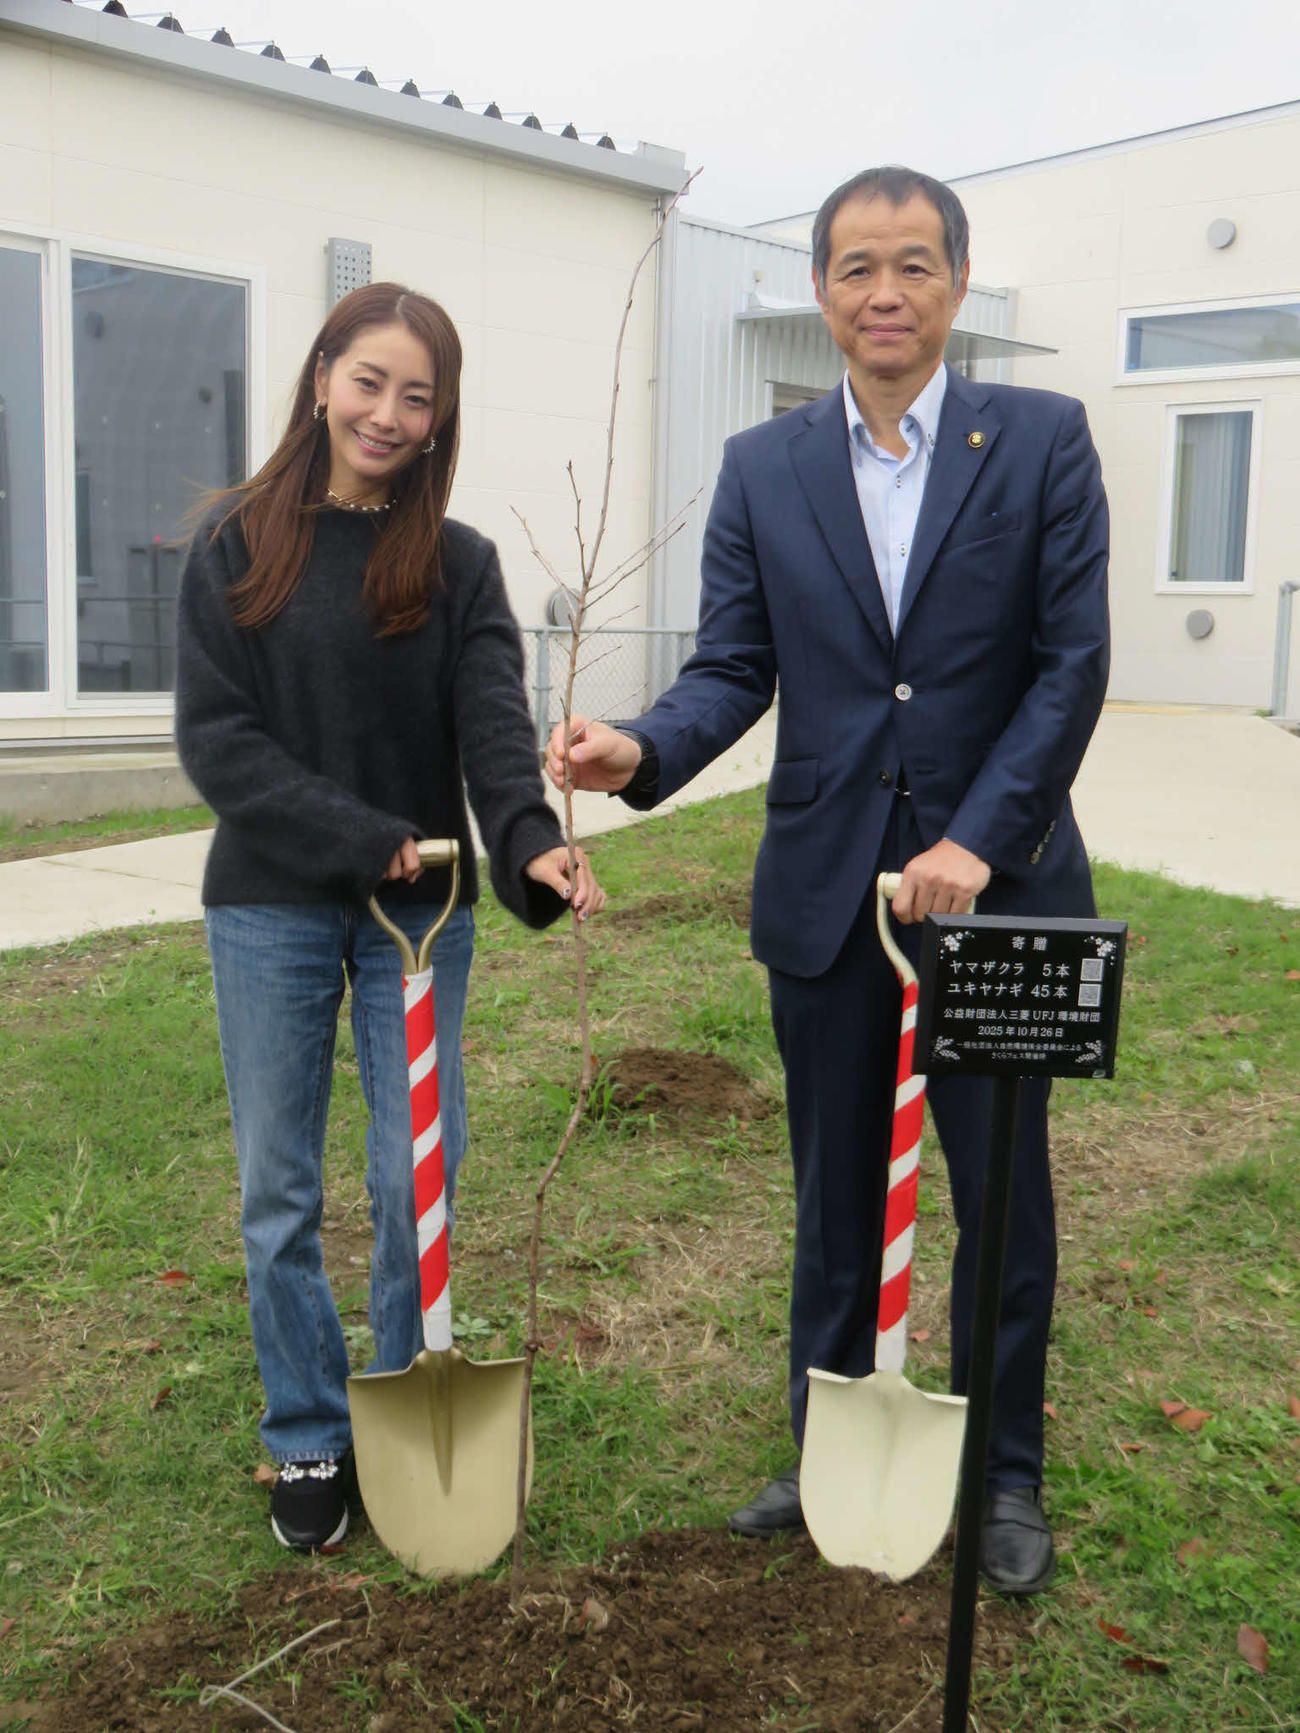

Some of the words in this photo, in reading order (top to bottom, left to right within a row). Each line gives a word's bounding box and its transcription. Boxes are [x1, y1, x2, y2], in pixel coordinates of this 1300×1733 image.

[950, 960, 1025, 975] ヤマザクラ
[1042, 963, 1070, 978] 5本
[948, 981, 1023, 997] ユキヤナギ
[1031, 984, 1068, 998] 45本
